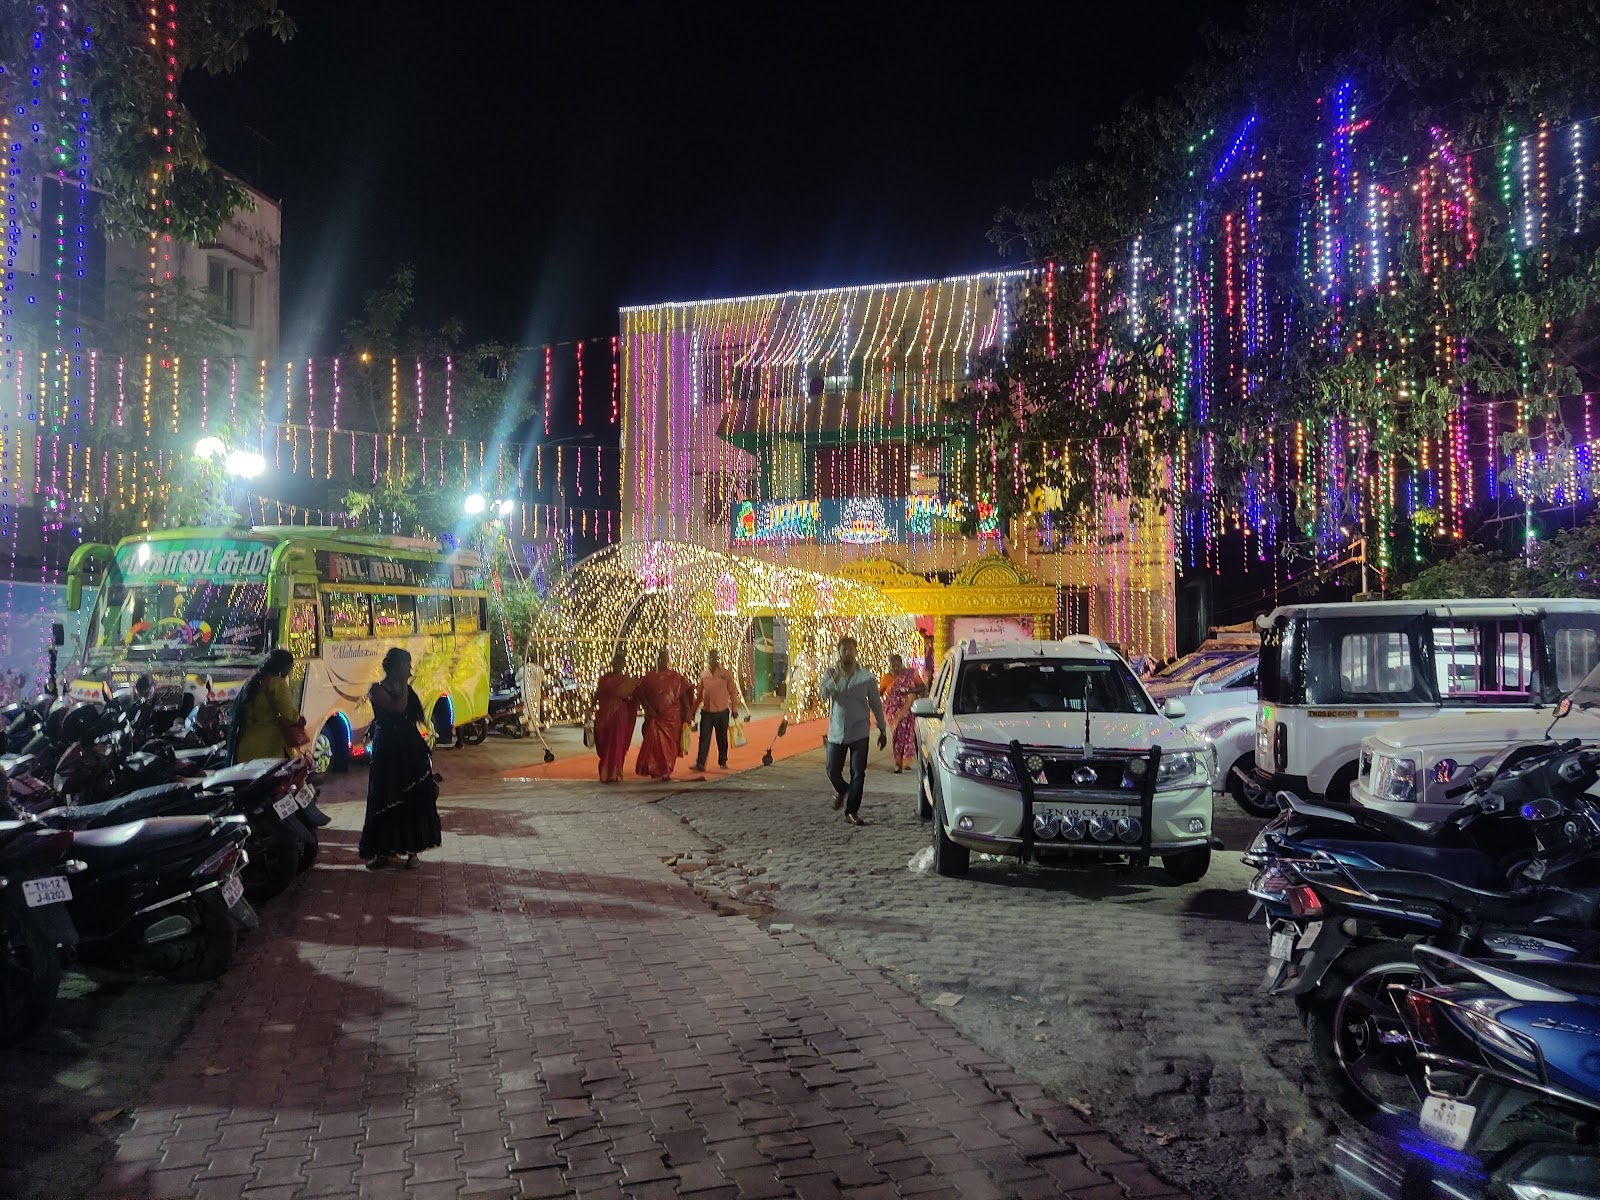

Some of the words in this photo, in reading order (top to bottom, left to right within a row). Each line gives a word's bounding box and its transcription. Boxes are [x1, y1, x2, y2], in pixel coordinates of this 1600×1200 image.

[335, 559, 365, 577] ALL
[372, 561, 405, 583] DAY
[1082, 809, 1099, 817] CK
[1102, 809, 1127, 818] 6712
